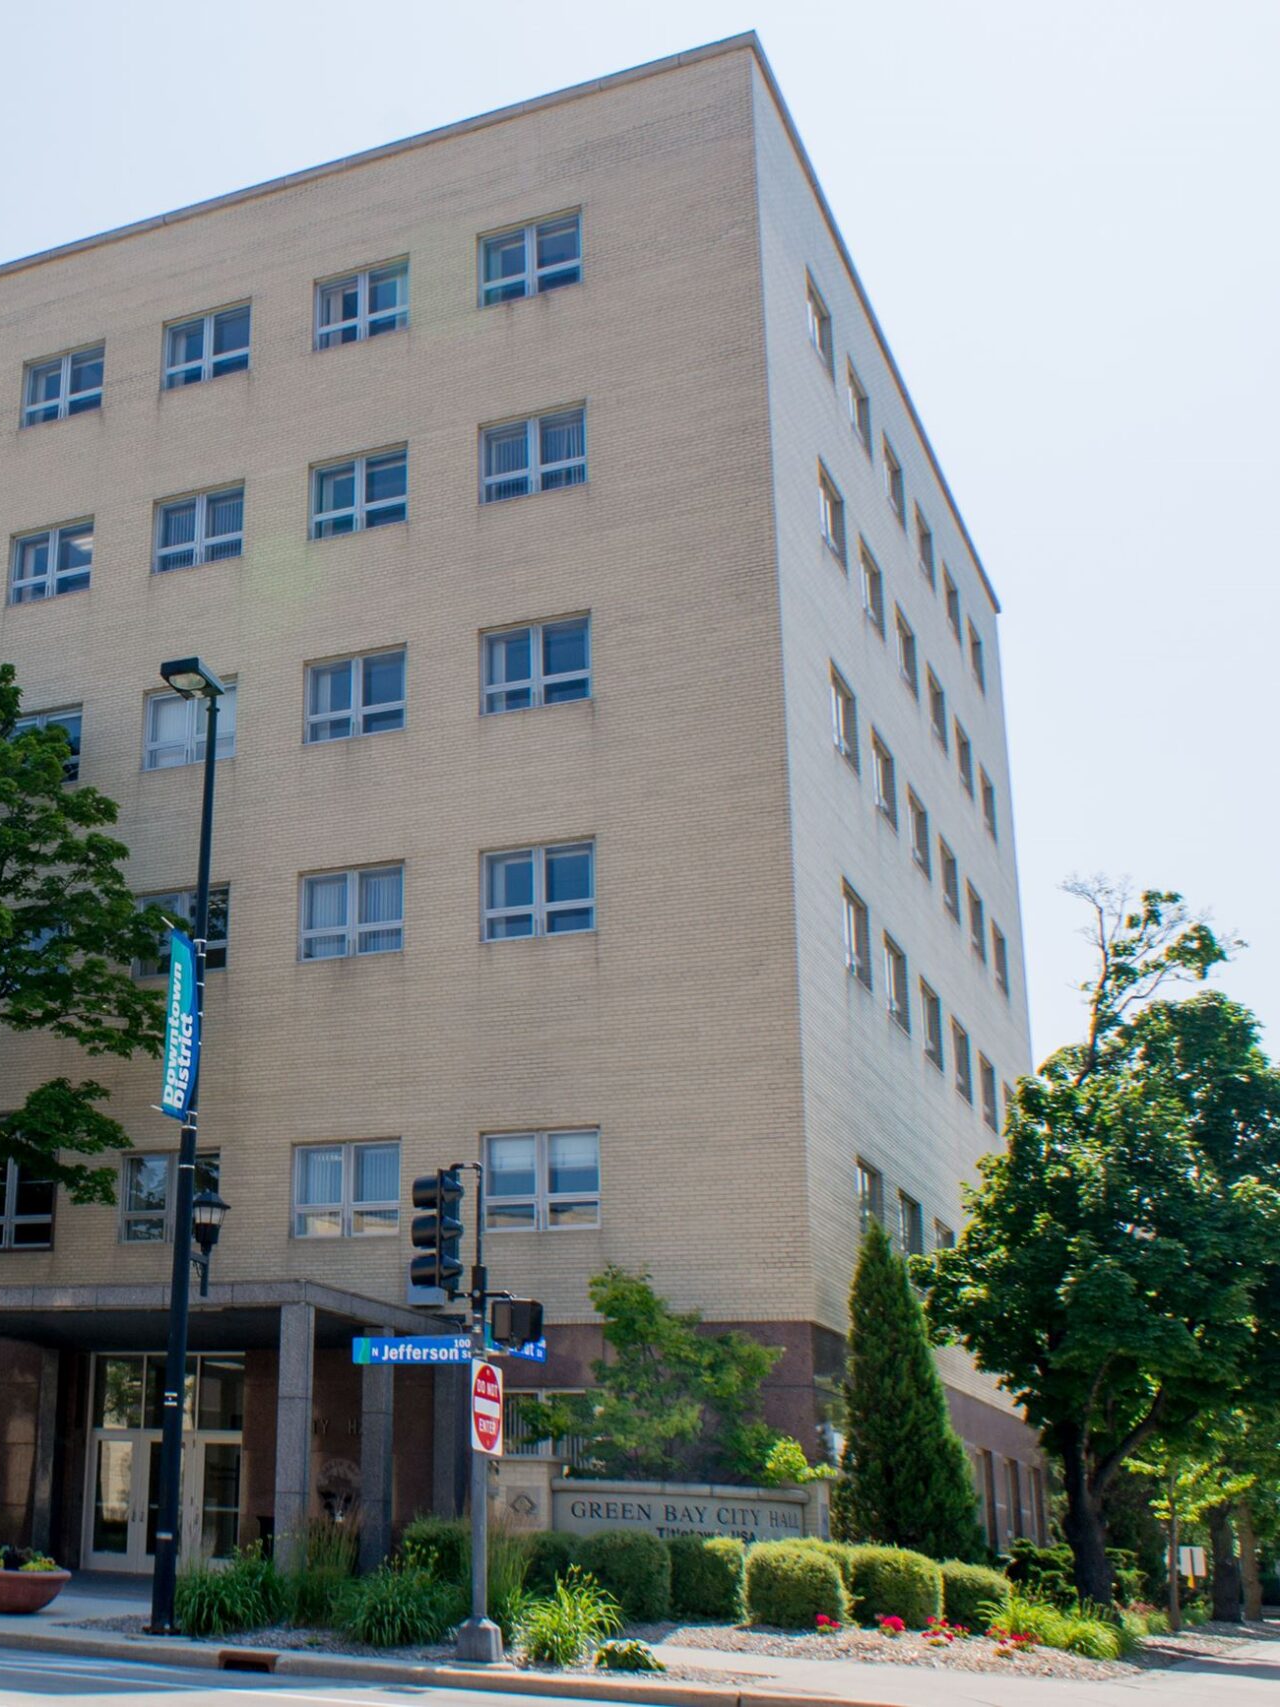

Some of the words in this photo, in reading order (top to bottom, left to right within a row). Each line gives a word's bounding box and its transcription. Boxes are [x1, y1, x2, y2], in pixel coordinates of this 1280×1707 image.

[163, 962, 182, 1104] Downtown
[172, 1012, 193, 1109] District
[371, 1347, 379, 1357] N
[382, 1344, 459, 1361] Jefferson
[454, 1339, 471, 1349] 100
[476, 1379, 486, 1394] DO
[487, 1382, 498, 1398] NOT
[479, 1417, 496, 1435] ENTER
[571, 1501, 651, 1521] GREEN
[664, 1503, 707, 1524] BAY
[716, 1506, 762, 1527] CITY
[768, 1509, 800, 1529] HALL
